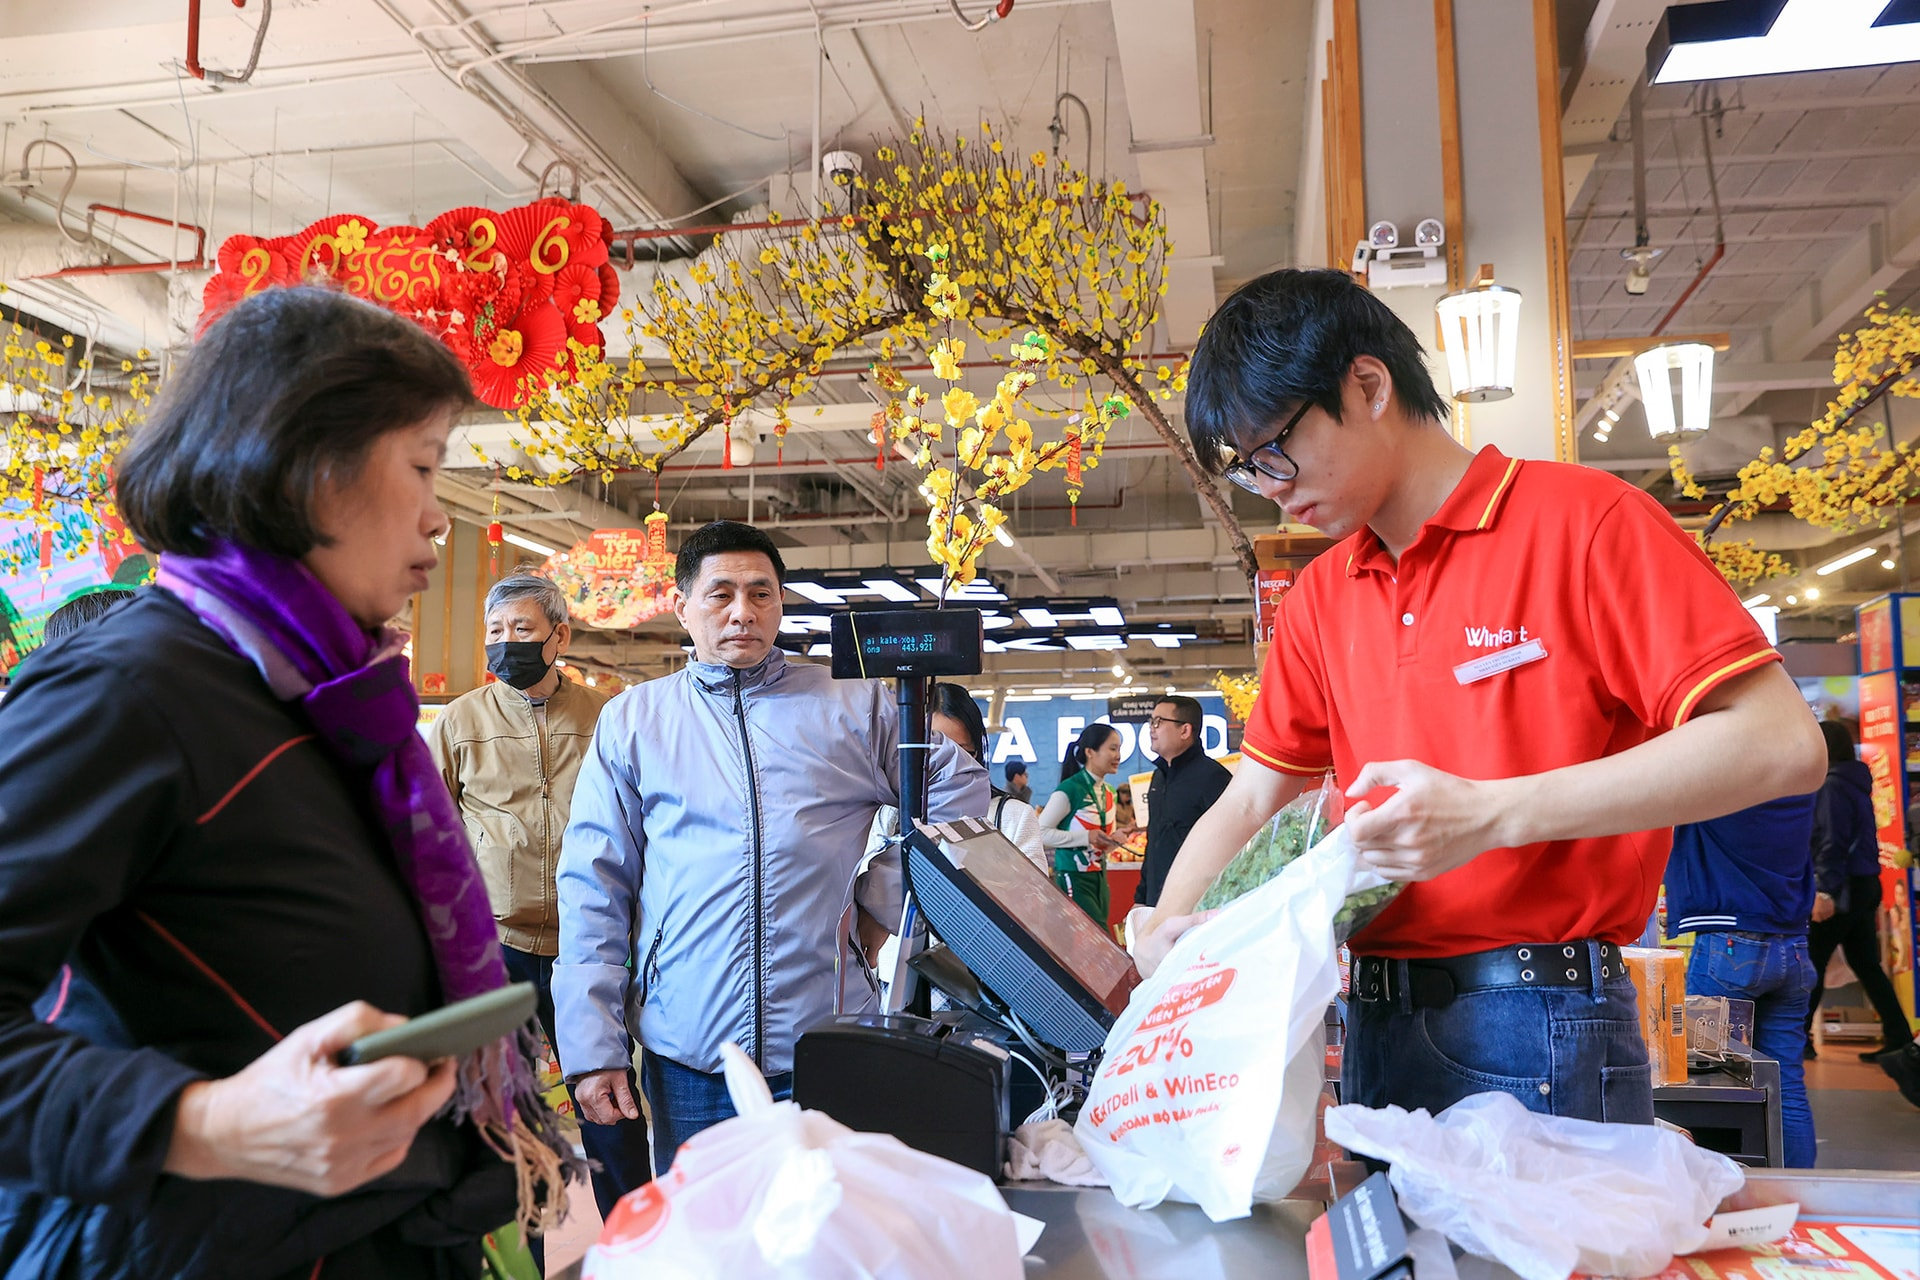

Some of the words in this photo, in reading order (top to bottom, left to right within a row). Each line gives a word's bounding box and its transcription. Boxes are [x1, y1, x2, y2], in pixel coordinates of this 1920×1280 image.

[880, 635, 898, 645] kale
[901, 643, 933, 652] 443,921
[1146, 1082, 1158, 1099] &
[1164, 1072, 1239, 1099] WinEco
